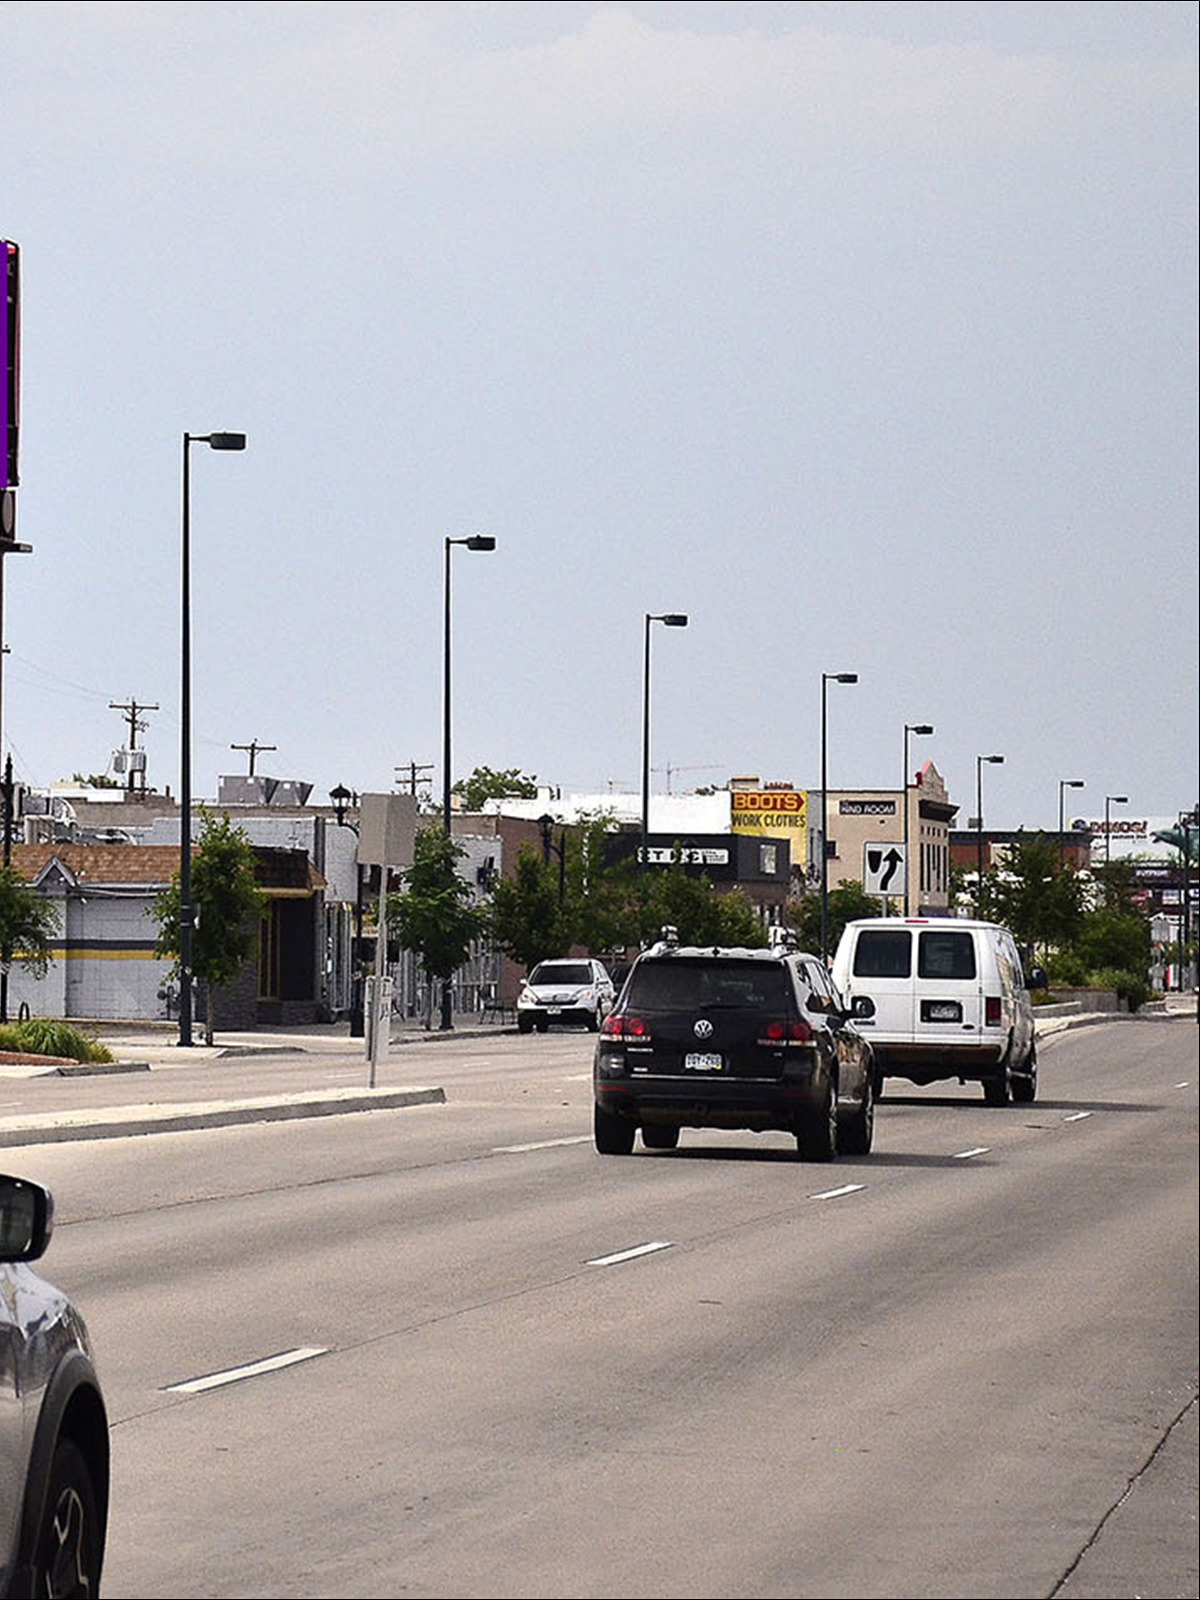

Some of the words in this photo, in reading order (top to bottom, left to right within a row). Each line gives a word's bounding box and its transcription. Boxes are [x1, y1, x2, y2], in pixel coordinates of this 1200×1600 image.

[733, 794, 798, 809] BOOTS
[732, 812, 762, 827] WORK
[763, 813, 806, 828] CLOTHES
